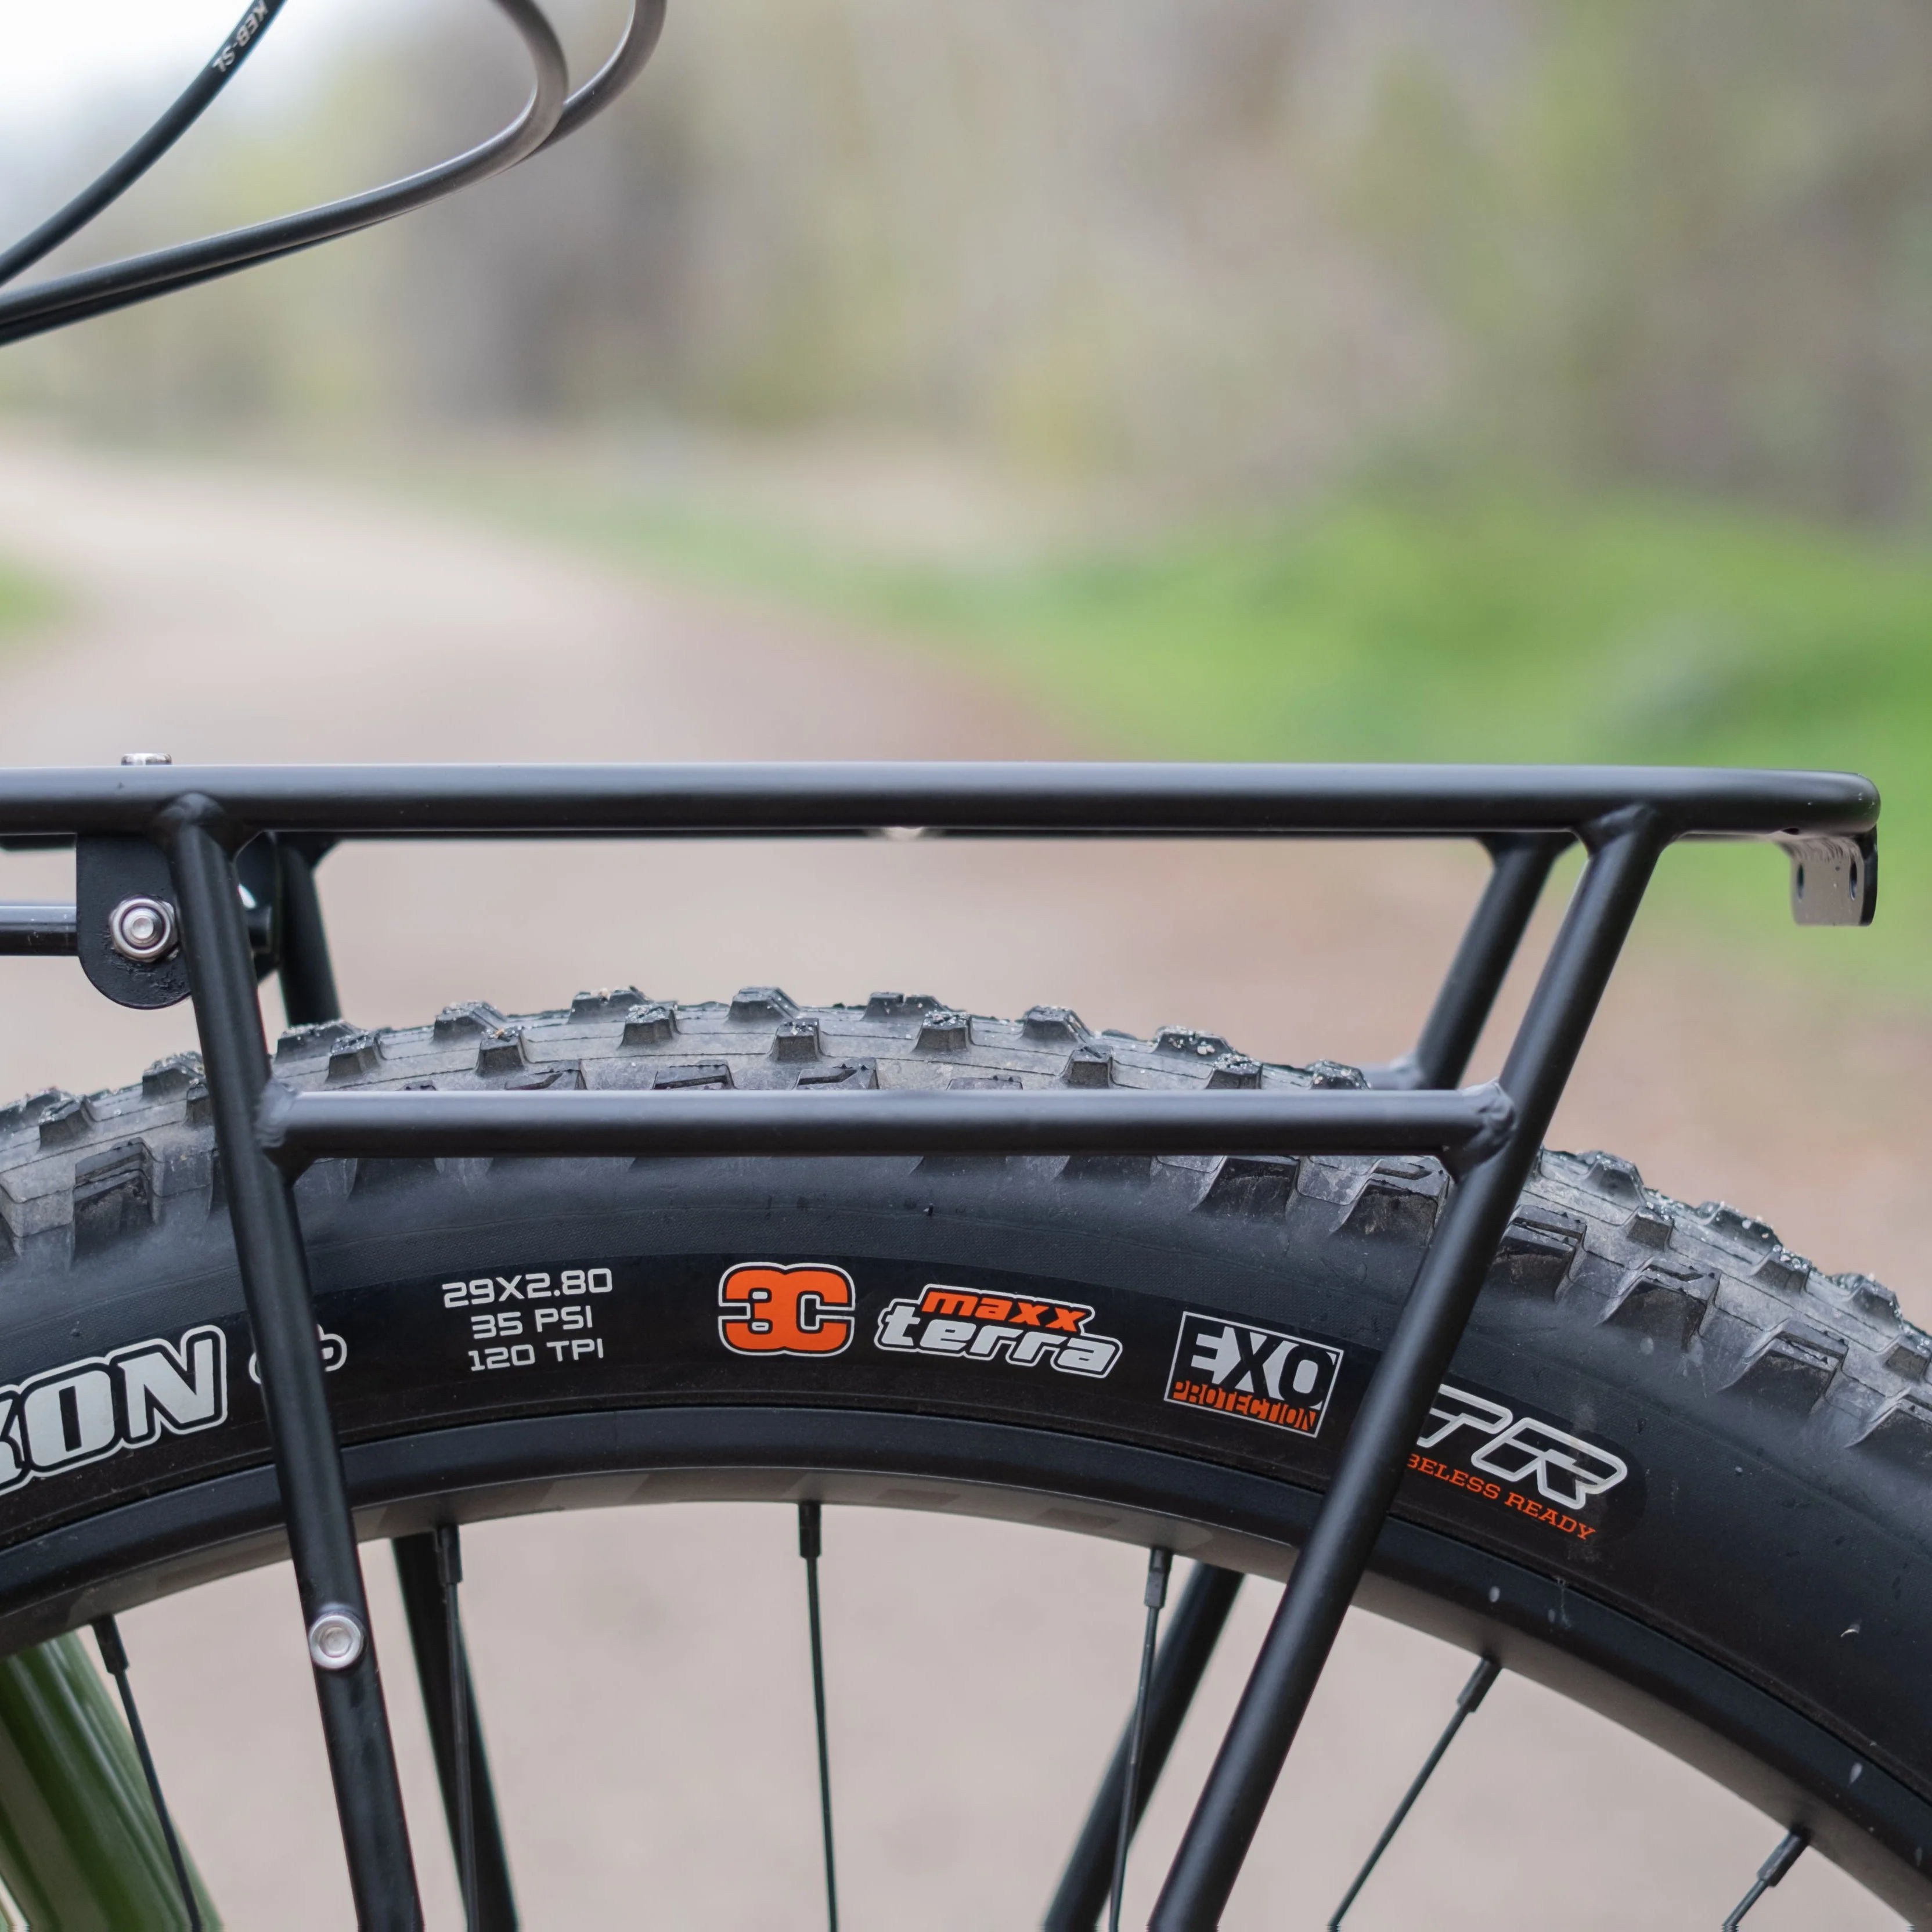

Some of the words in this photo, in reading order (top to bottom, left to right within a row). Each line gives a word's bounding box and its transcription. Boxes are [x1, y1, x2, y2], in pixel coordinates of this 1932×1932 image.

[442, 1268, 613, 1309] 29X2.80
[718, 1261, 856, 1357] 3C
[920, 1289, 1091, 1334] maxx
[470, 1312, 523, 1339] 35
[535, 1305, 593, 1332] PSI
[875, 1302, 1122, 1378] terra
[468, 1344, 536, 1371] 120
[546, 1338, 604, 1362] TPI
[1182, 1314, 1340, 1412] EXO
[0, 1324, 228, 1495] ON
[1173, 1379, 1317, 1431] PROTECTION
[1407, 1453, 1501, 1500] BELESS
[1504, 1491, 1596, 1540] READY
